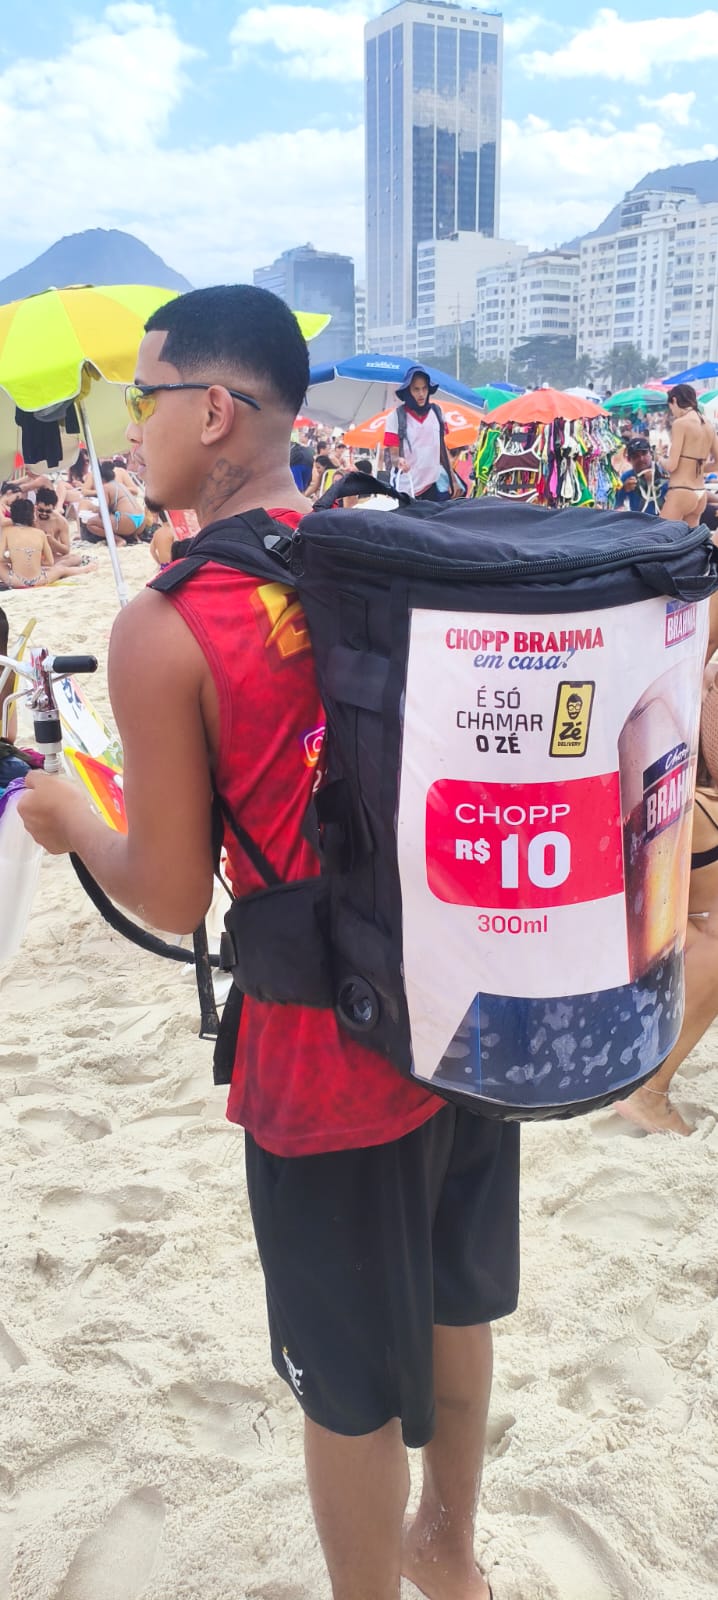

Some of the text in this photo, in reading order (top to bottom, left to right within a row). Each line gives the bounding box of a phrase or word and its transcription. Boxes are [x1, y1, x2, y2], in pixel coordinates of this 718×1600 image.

[445, 626, 605, 653] CHOPP BRAHMA
[473, 647, 576, 670] em casa?
[477, 685, 521, 709] É SÓ
[456, 710, 543, 732] CHAMAR
[559, 721, 583, 741] Zé
[475, 732, 521, 754] O ZÉ
[455, 804, 571, 825] CHOPP
[455, 831, 571, 888] R$ 10
[477, 914, 548, 934] 300ml
